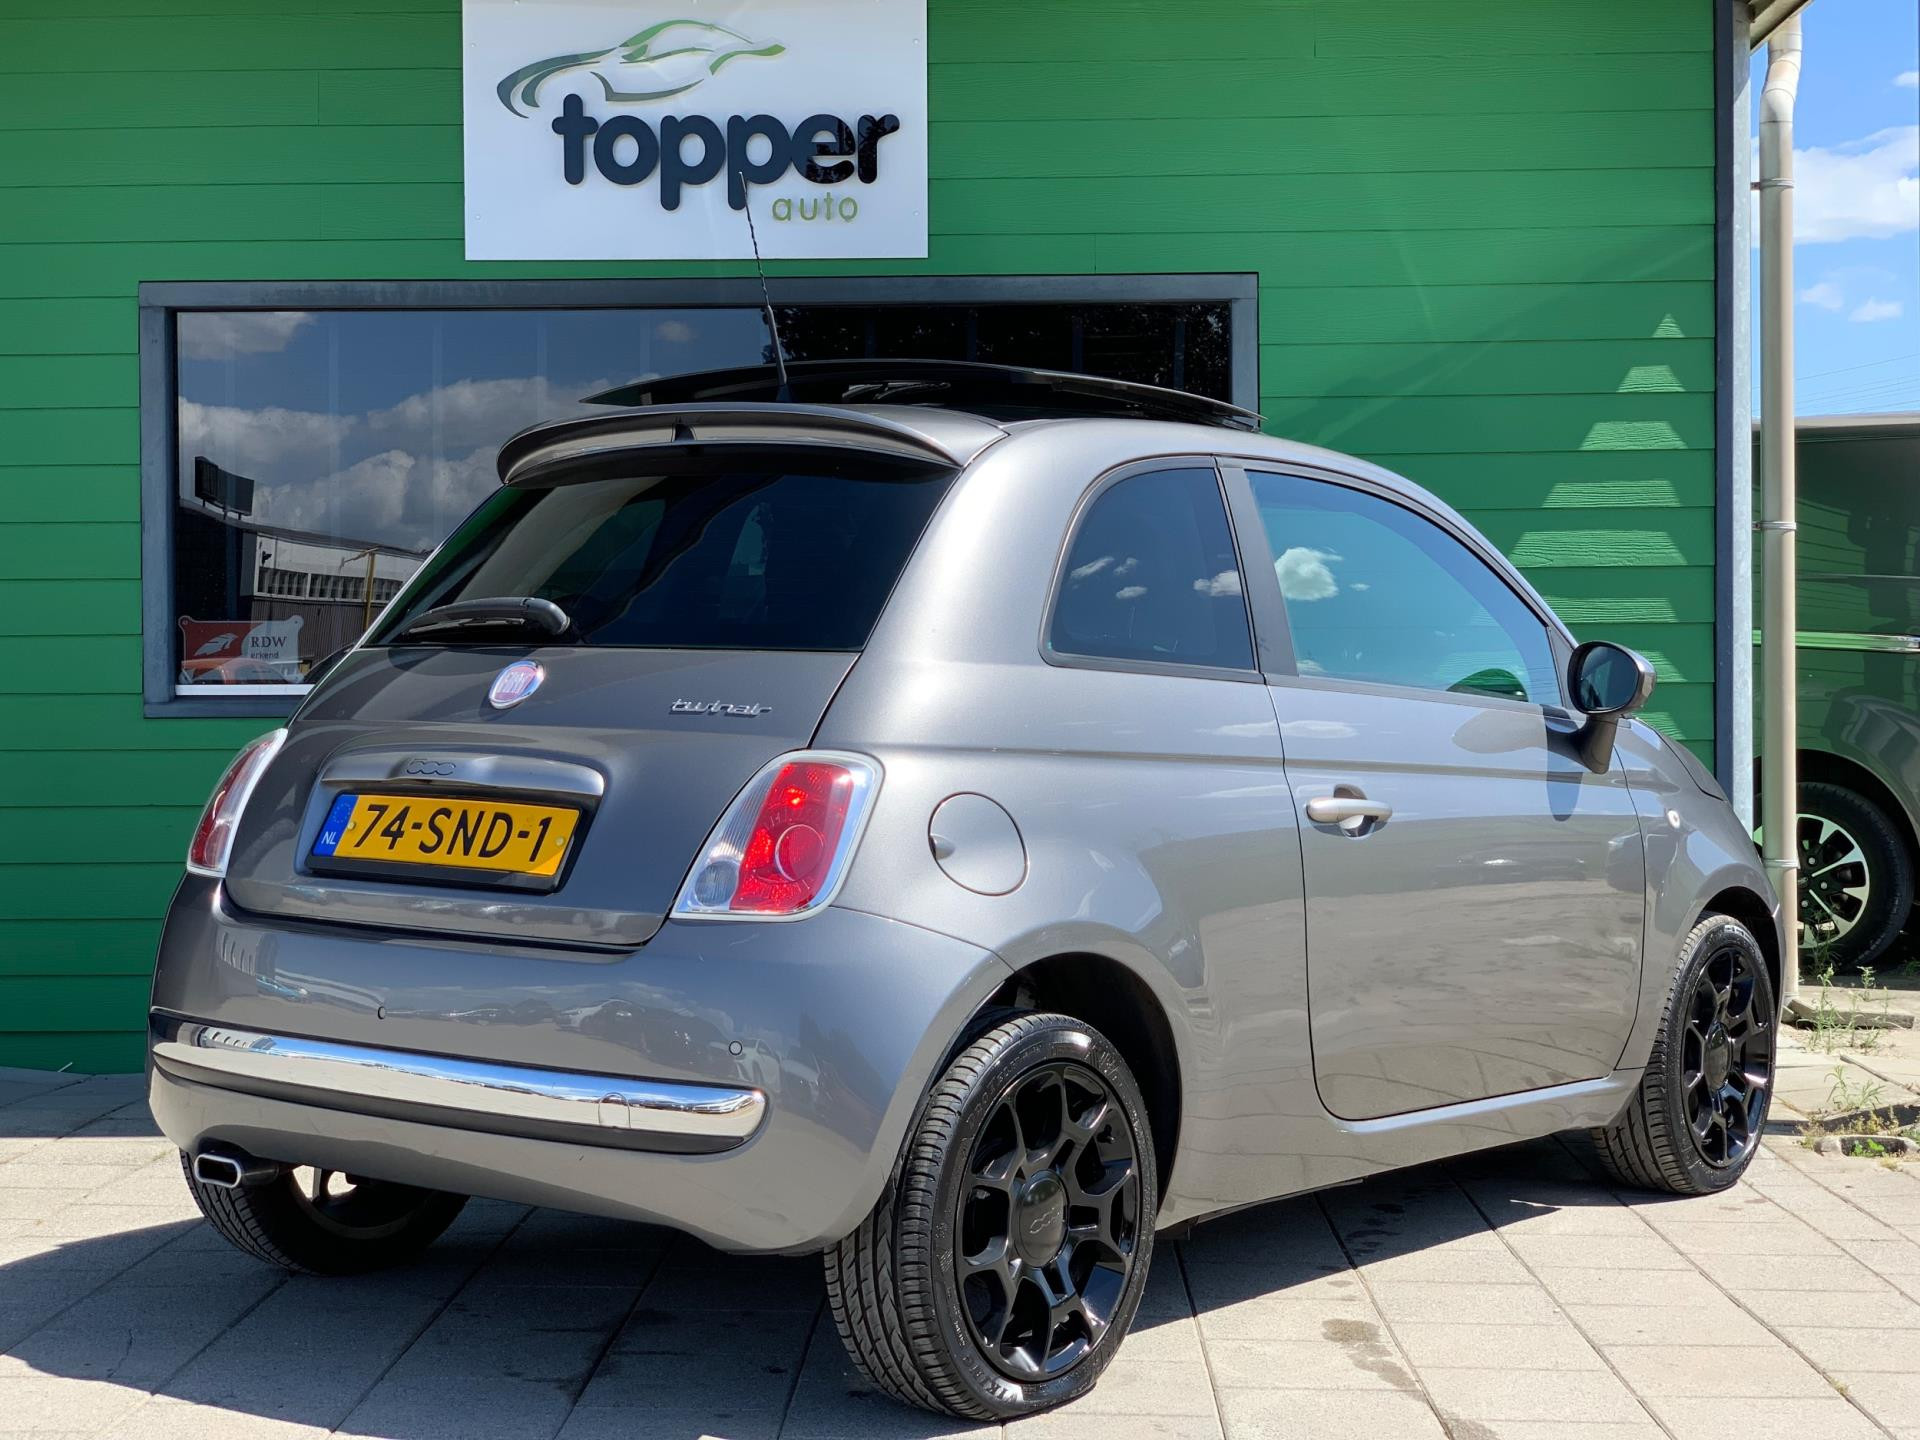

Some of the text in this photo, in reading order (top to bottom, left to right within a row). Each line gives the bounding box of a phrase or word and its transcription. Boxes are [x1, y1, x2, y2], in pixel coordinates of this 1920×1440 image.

[551, 93, 901, 211] topper
[771, 192, 858, 222] auto
[251, 636, 287, 647] RDW
[670, 698, 772, 715] twinair
[406, 758, 456, 776] 500
[321, 831, 337, 845] NL
[353, 804, 553, 863] 74-SND-1
